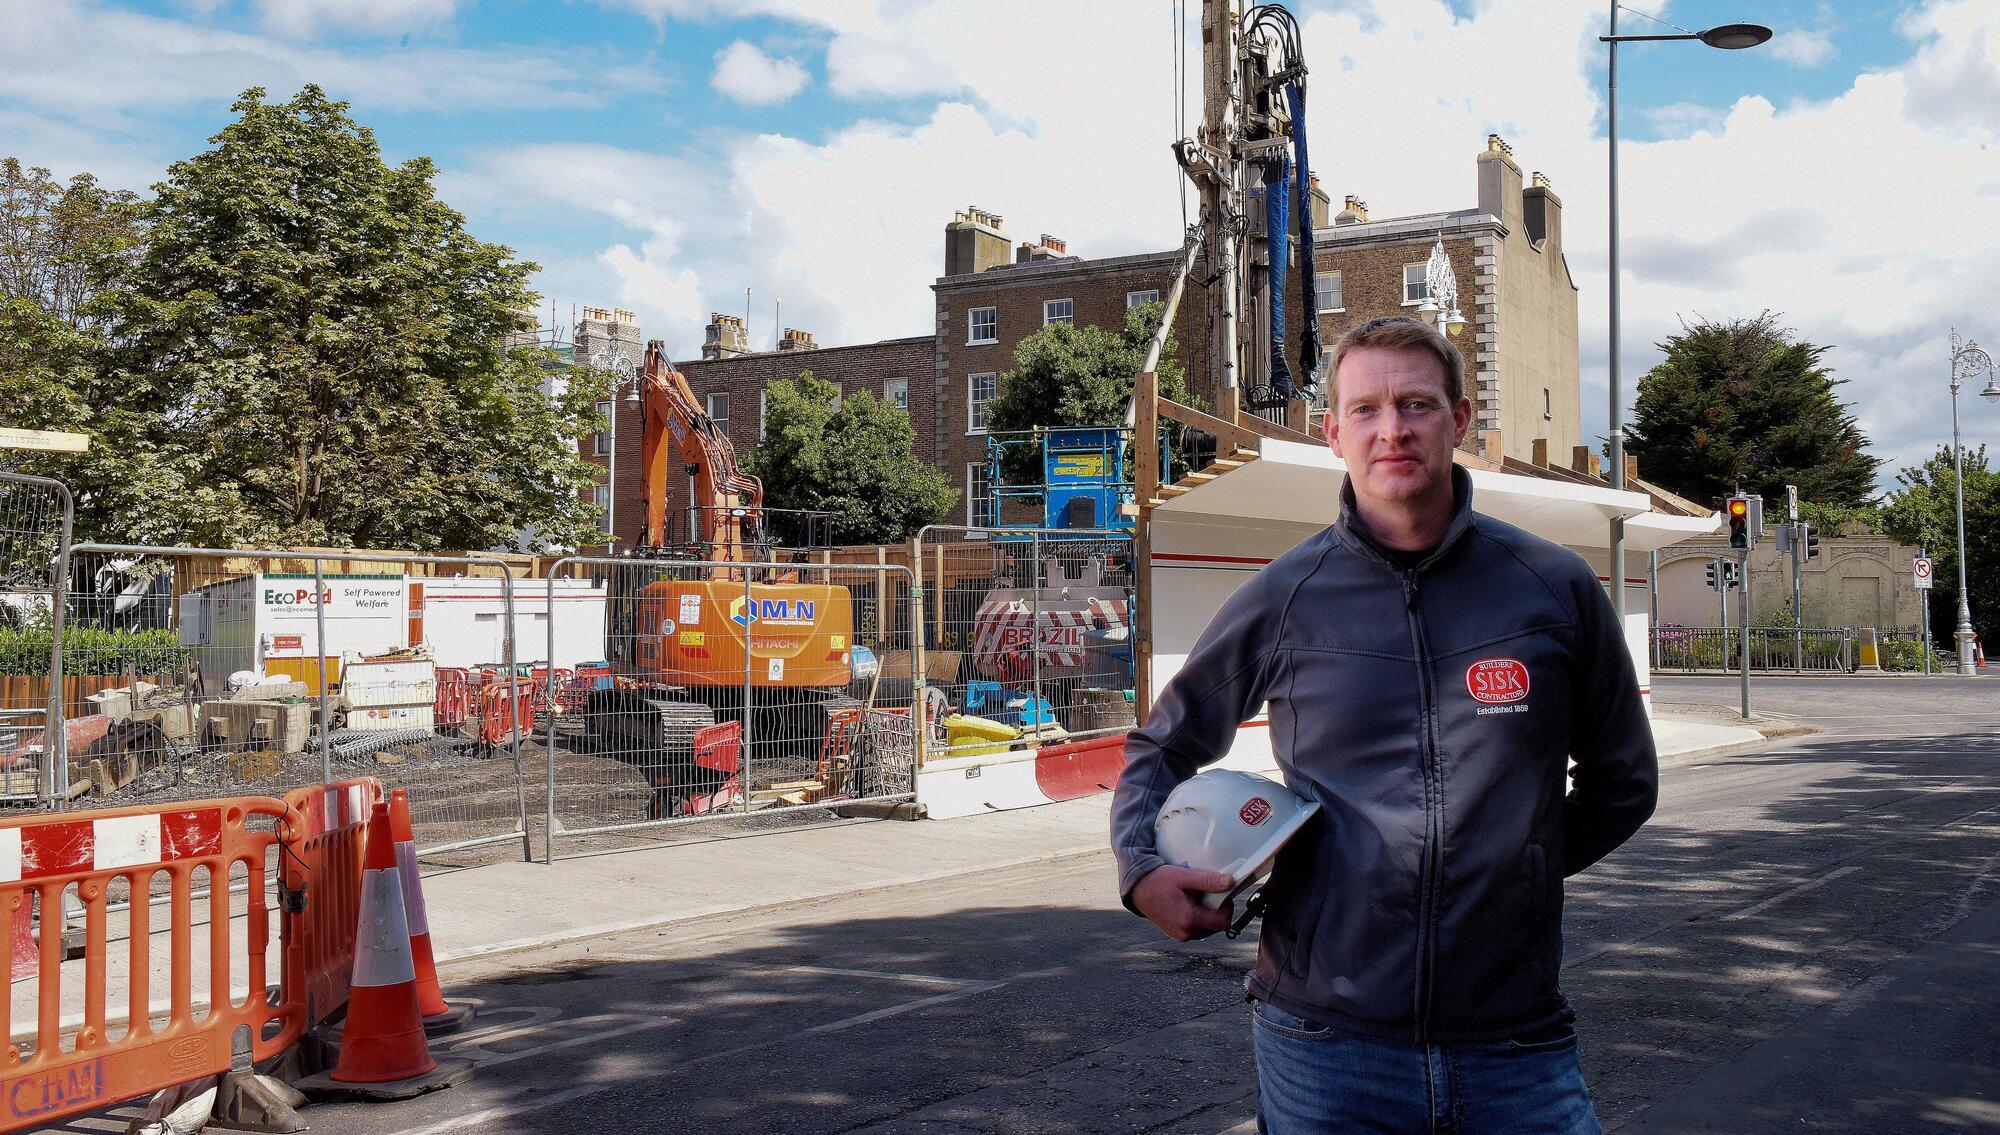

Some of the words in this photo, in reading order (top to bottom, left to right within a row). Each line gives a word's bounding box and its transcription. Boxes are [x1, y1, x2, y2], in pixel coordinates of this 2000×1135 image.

[344, 588, 361, 598] Self
[363, 588, 401, 597] Powered
[355, 600, 389, 609] Welfare
[761, 599, 815, 620] M&N
[1005, 628, 1078, 646] BRAZIL
[750, 638, 799, 649] HITACHI
[1478, 661, 1514, 671] BUILDERS
[1475, 670, 1522, 691] SISK
[1476, 689, 1525, 700] CONTRACTORS
[1477, 705, 1513, 716] Established
[1514, 704, 1529, 713] 1859
[1243, 800, 1267, 823] SISK
